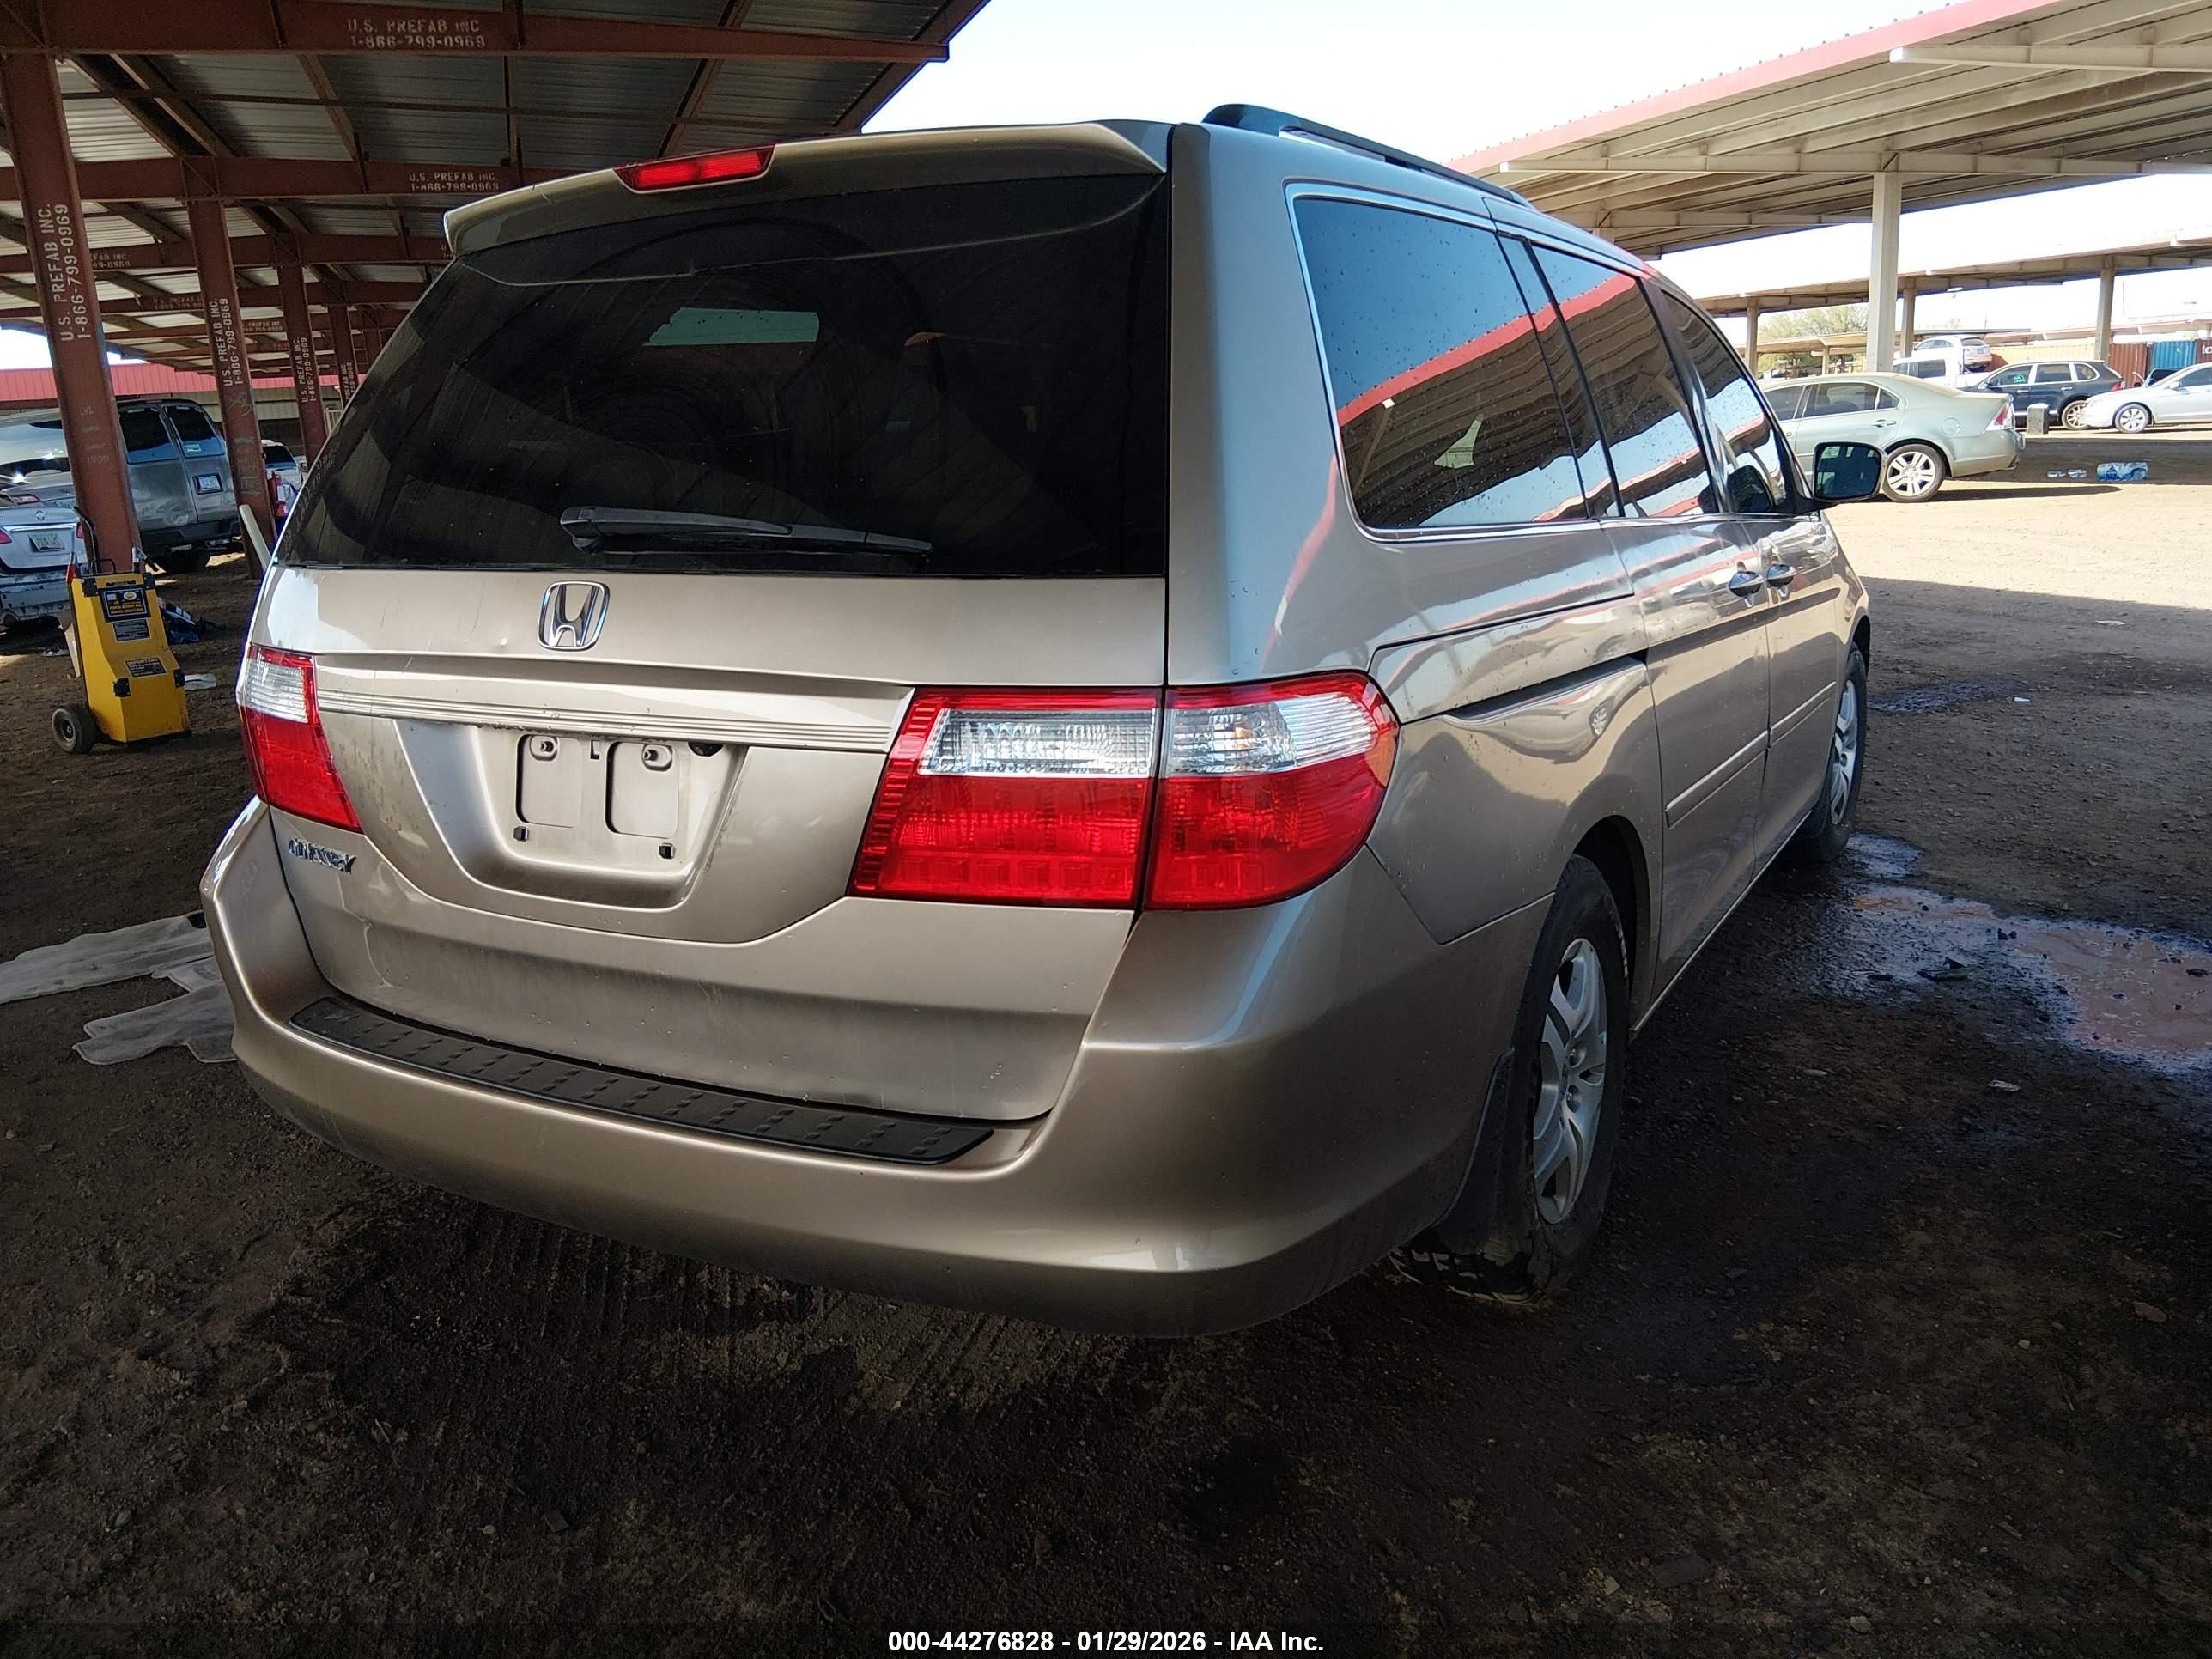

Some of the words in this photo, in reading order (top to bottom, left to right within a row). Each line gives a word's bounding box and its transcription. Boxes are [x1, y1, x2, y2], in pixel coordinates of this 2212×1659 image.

[347, 18, 379, 33] U.S.
[386, 19, 448, 33] PREFAB
[349, 34, 486, 49] 1-866-799-0969
[411, 181, 500, 192] 1-866-799-0969
[433, 171, 474, 182] PREFAB
[37, 203, 56, 234] INC.
[43, 240, 69, 303] PREFAB
[53, 204, 93, 339] 1-866-799-0969
[208, 296, 221, 319] INC.
[58, 311, 76, 342] U.S.
[212, 321, 229, 362] PREFAB
[219, 297, 244, 385] 1-866-799-0969
[221, 366, 233, 386] U.S.
[294, 354, 307, 386] PREFAB
[301, 337, 317, 402] 1-866-799-0969
